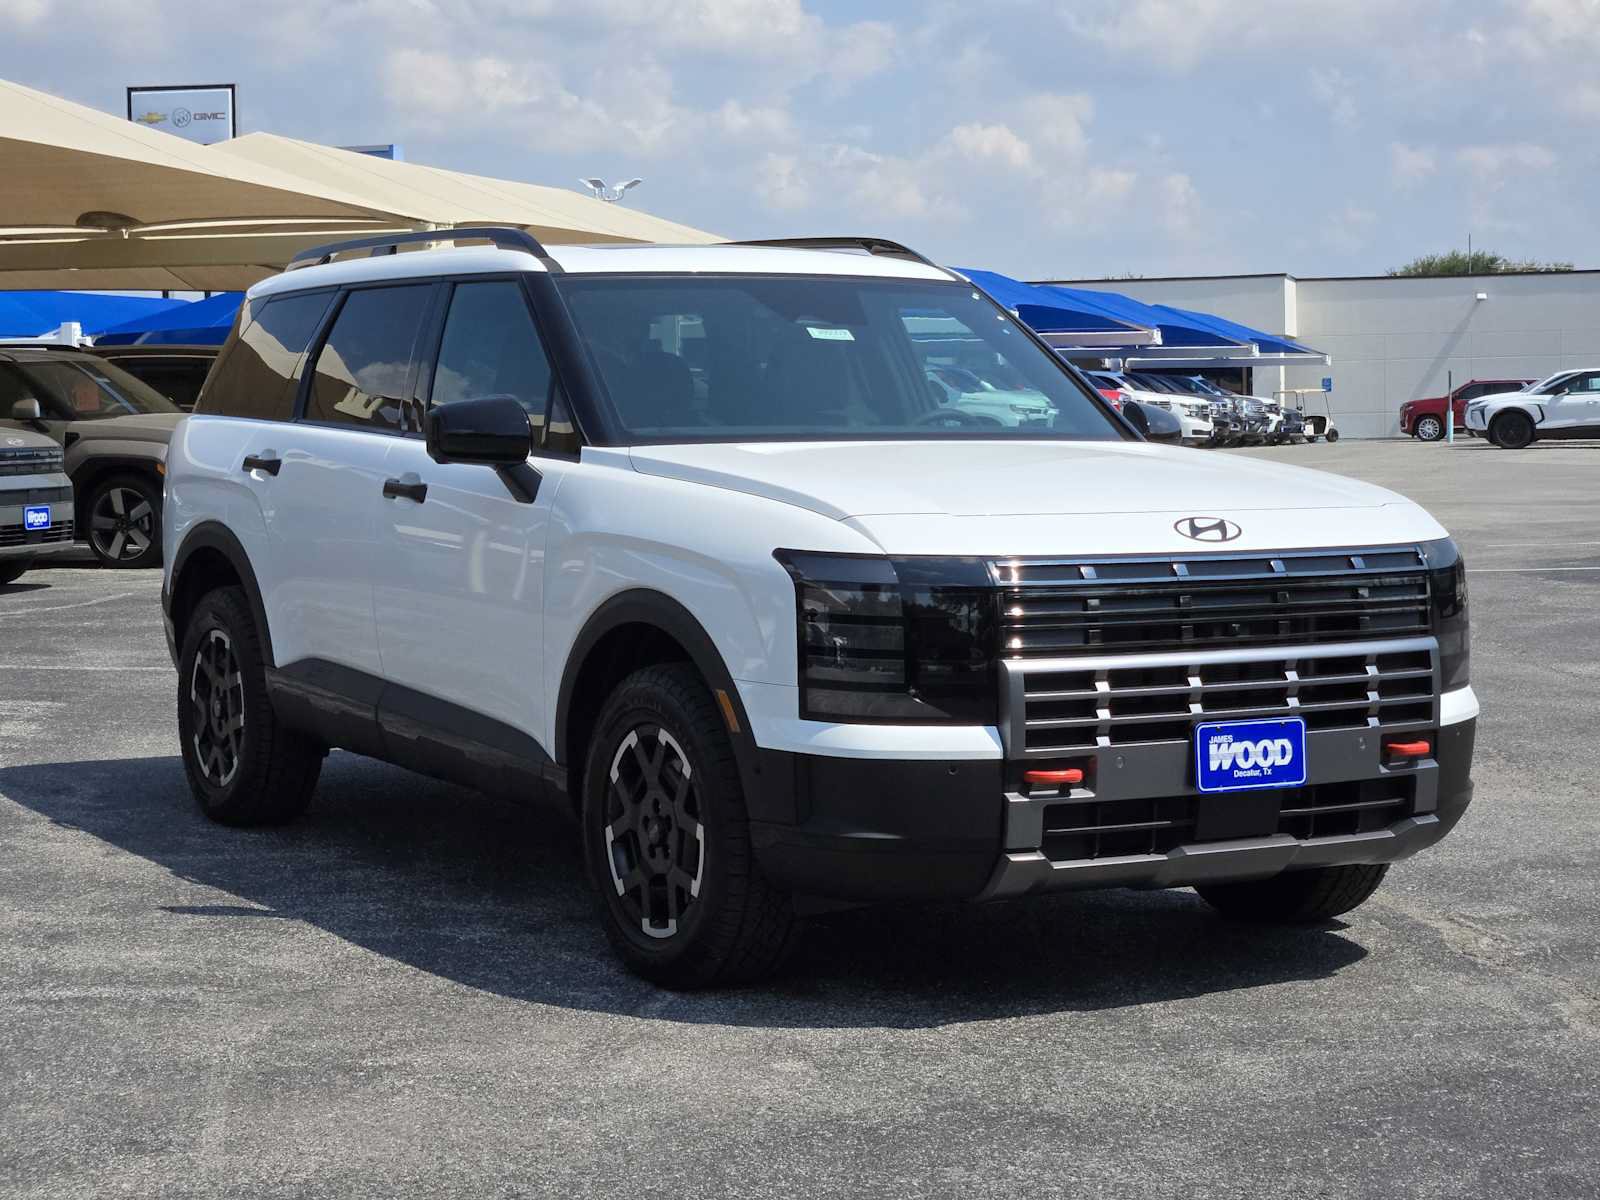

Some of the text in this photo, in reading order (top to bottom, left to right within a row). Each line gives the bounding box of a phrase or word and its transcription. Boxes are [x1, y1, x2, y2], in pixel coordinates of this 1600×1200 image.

[193, 112, 226, 121] GMC
[1209, 735, 1233, 744] JAMES
[1209, 739, 1293, 771] WOOD
[1233, 769, 1262, 778] Decatur,
